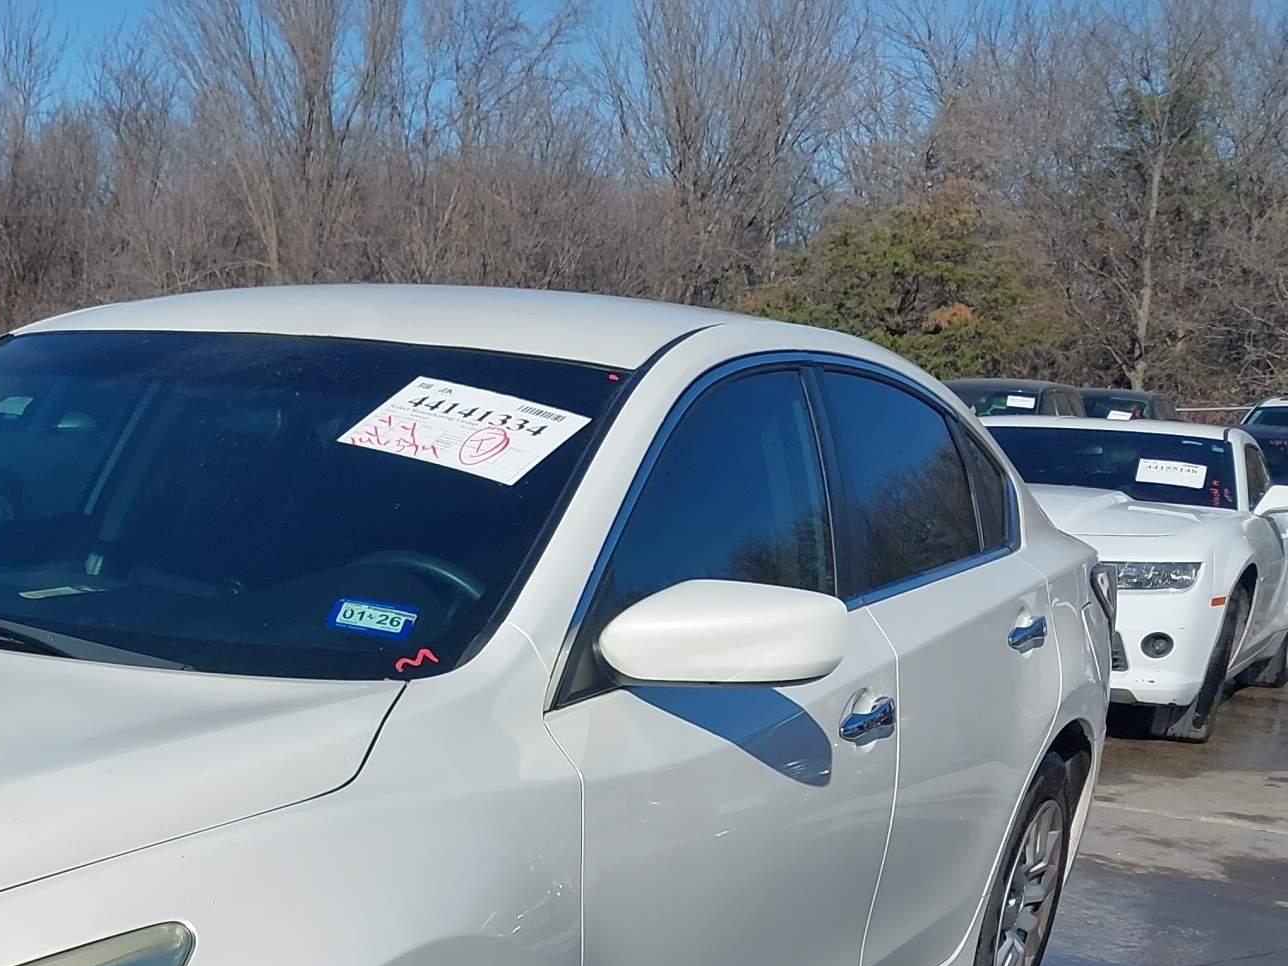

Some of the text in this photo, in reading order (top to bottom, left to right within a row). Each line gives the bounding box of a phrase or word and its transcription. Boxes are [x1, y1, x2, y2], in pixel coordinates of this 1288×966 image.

[407, 395, 549, 437] 44141334
[342, 607, 403, 628] 01 26
